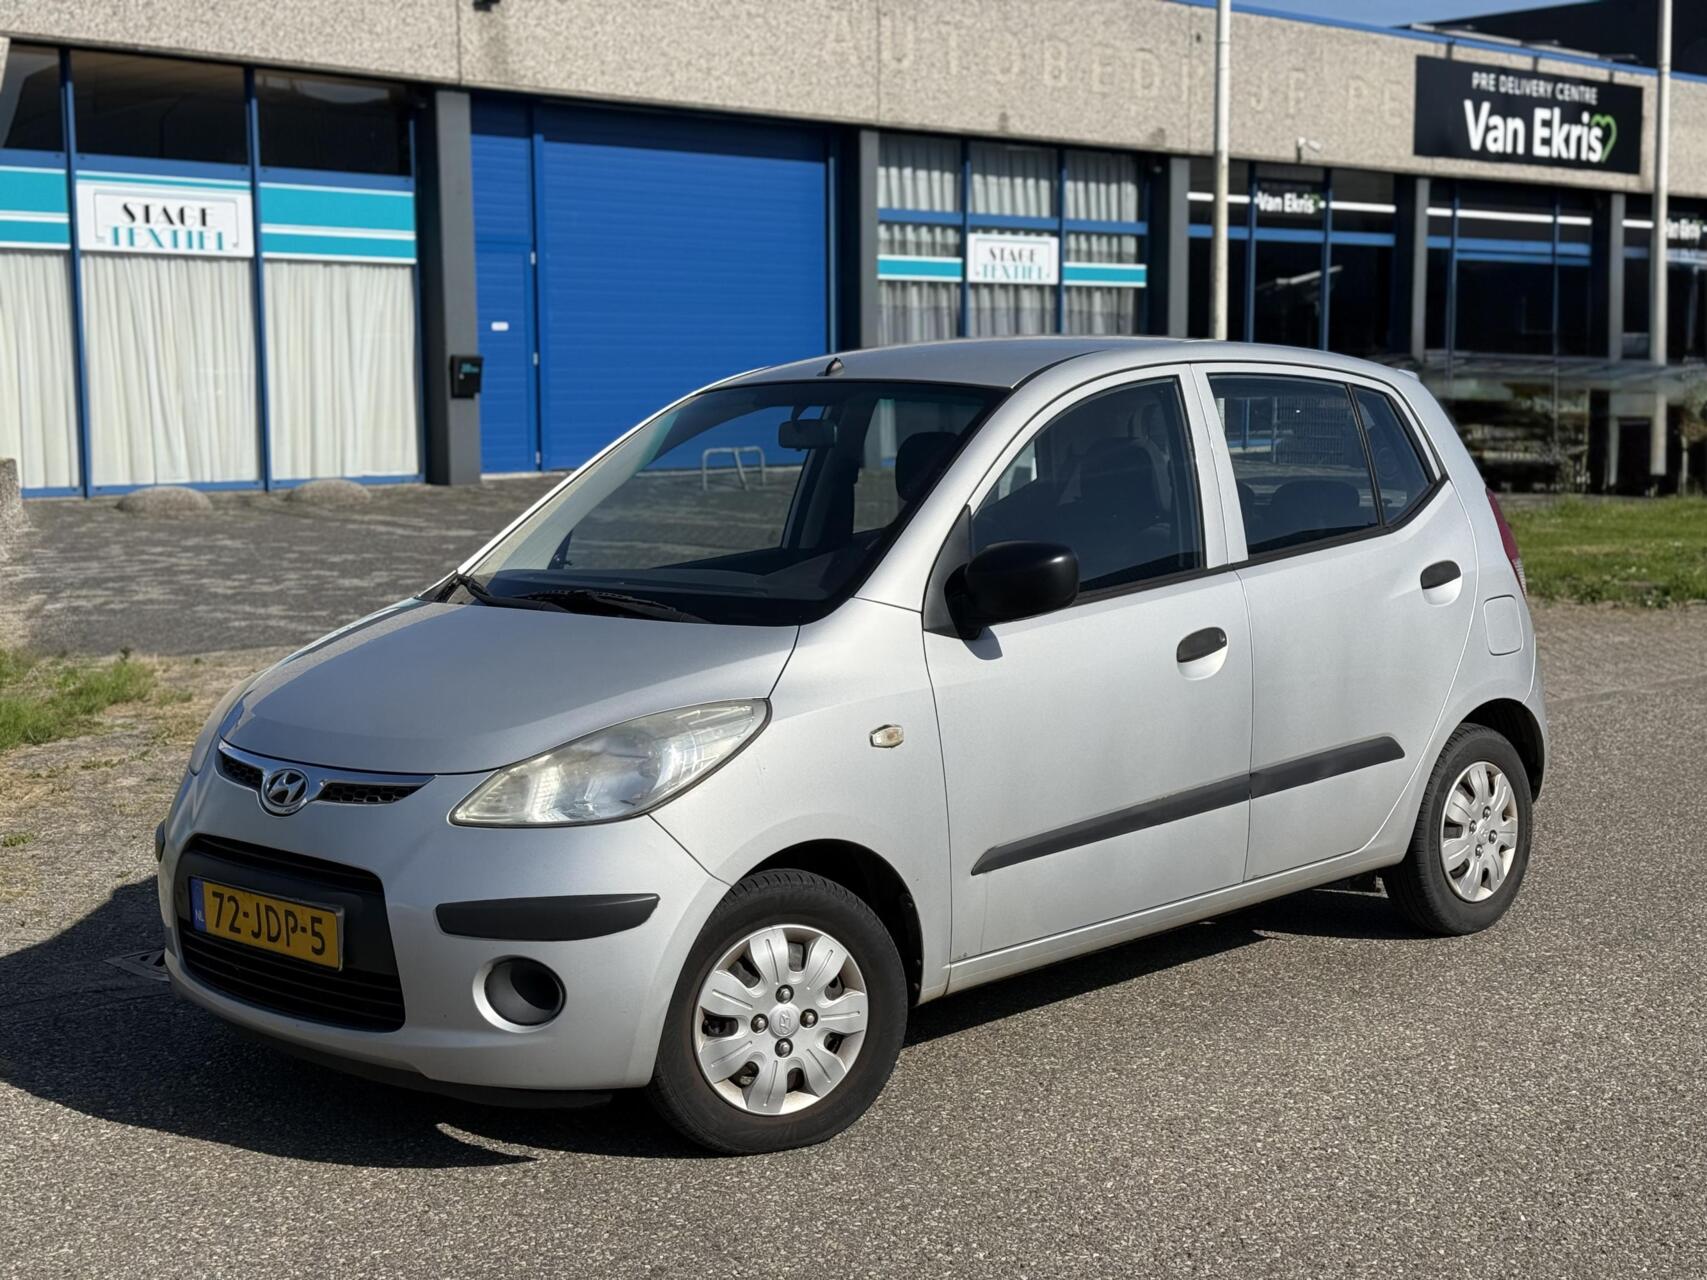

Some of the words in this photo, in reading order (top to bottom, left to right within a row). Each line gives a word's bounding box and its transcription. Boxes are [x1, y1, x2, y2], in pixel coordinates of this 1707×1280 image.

[1472, 71, 1496, 92] PRE
[1499, 73, 1553, 98] DELIVERY
[1555, 82, 1598, 105] CENTRE
[1463, 99, 1525, 155] Van
[1532, 106, 1603, 163] Ekris
[120, 202, 215, 228] STAGE
[1257, 191, 1283, 212] Van
[1283, 192, 1316, 214] Ekris
[104, 225, 231, 251] TEXTIEL
[195, 909, 205, 922] NL
[211, 890, 326, 956] 72-JDP-5
